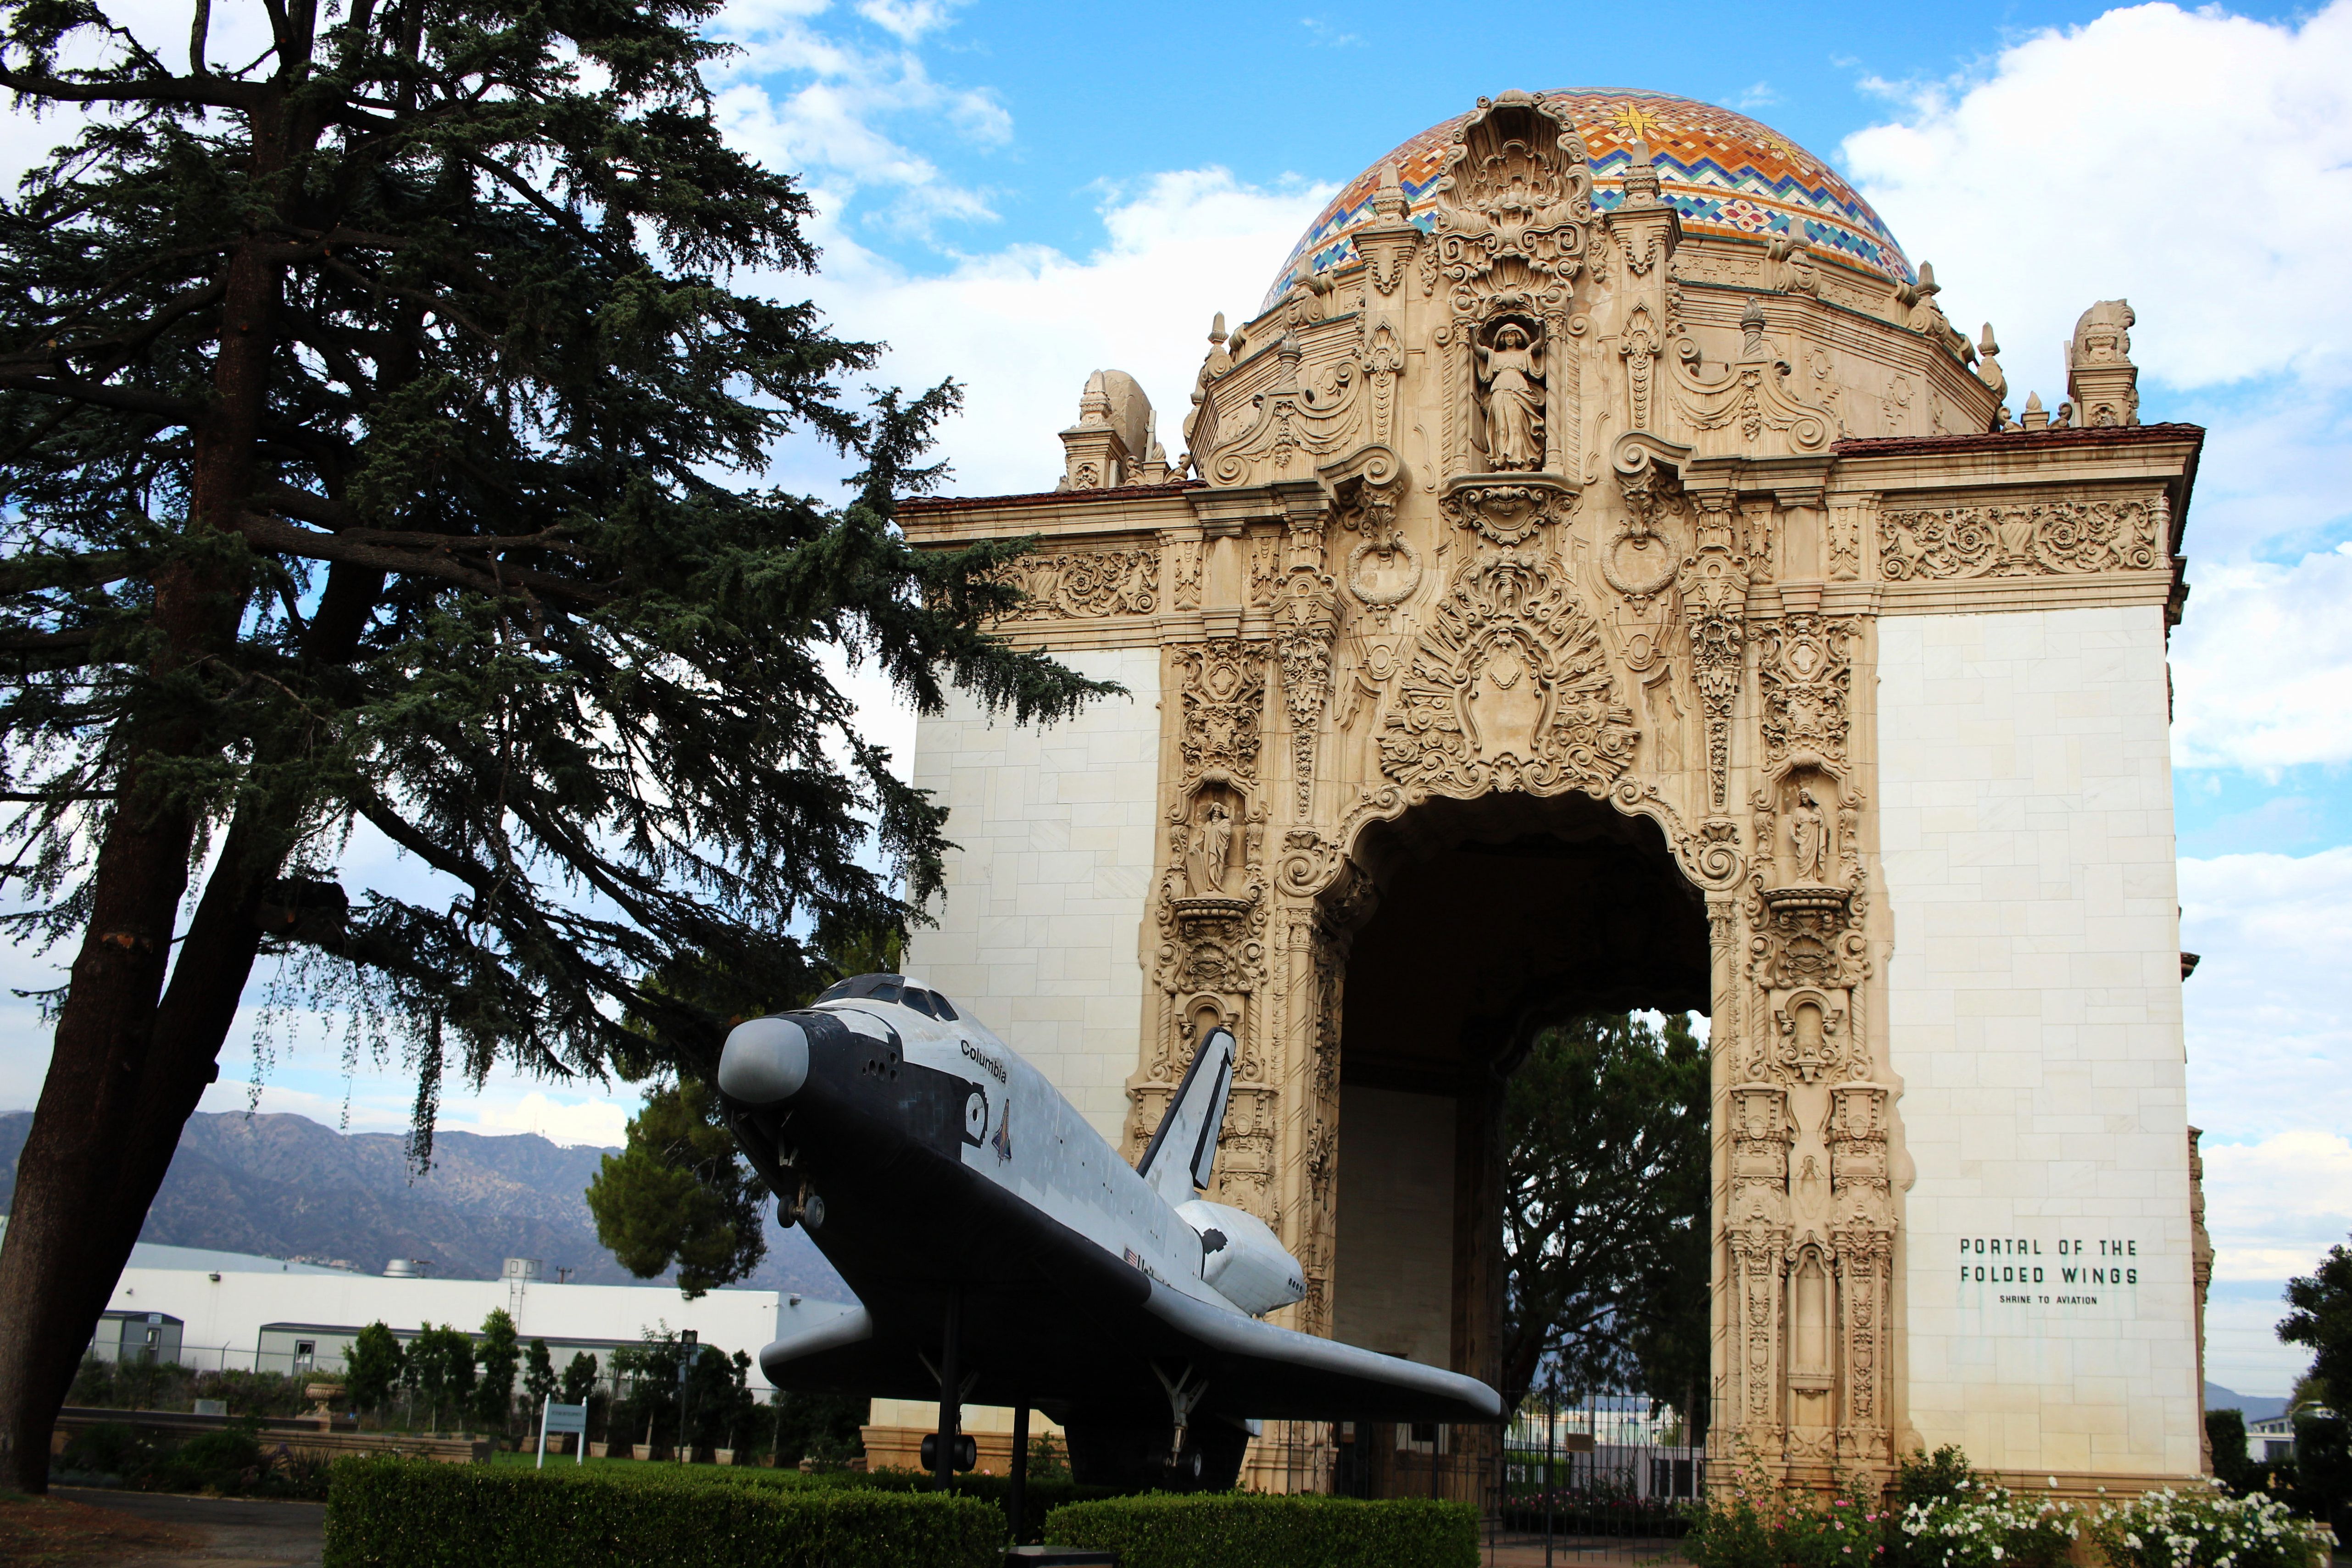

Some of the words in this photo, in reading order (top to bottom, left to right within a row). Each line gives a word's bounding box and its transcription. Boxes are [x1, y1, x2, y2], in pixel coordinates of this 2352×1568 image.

[961, 1040, 1006, 1084] Columbia
[1960, 1239, 2041, 1255] PORTAL
[2059, 1240, 2082, 1255] OF
[2099, 1240, 2136, 1256] THE
[1961, 1266, 2043, 1283] FOLDED
[2062, 1268, 2137, 1284] WINGS
[1999, 1295, 2031, 1304] SHRINE
[2056, 1296, 2098, 1305] AVIATION
